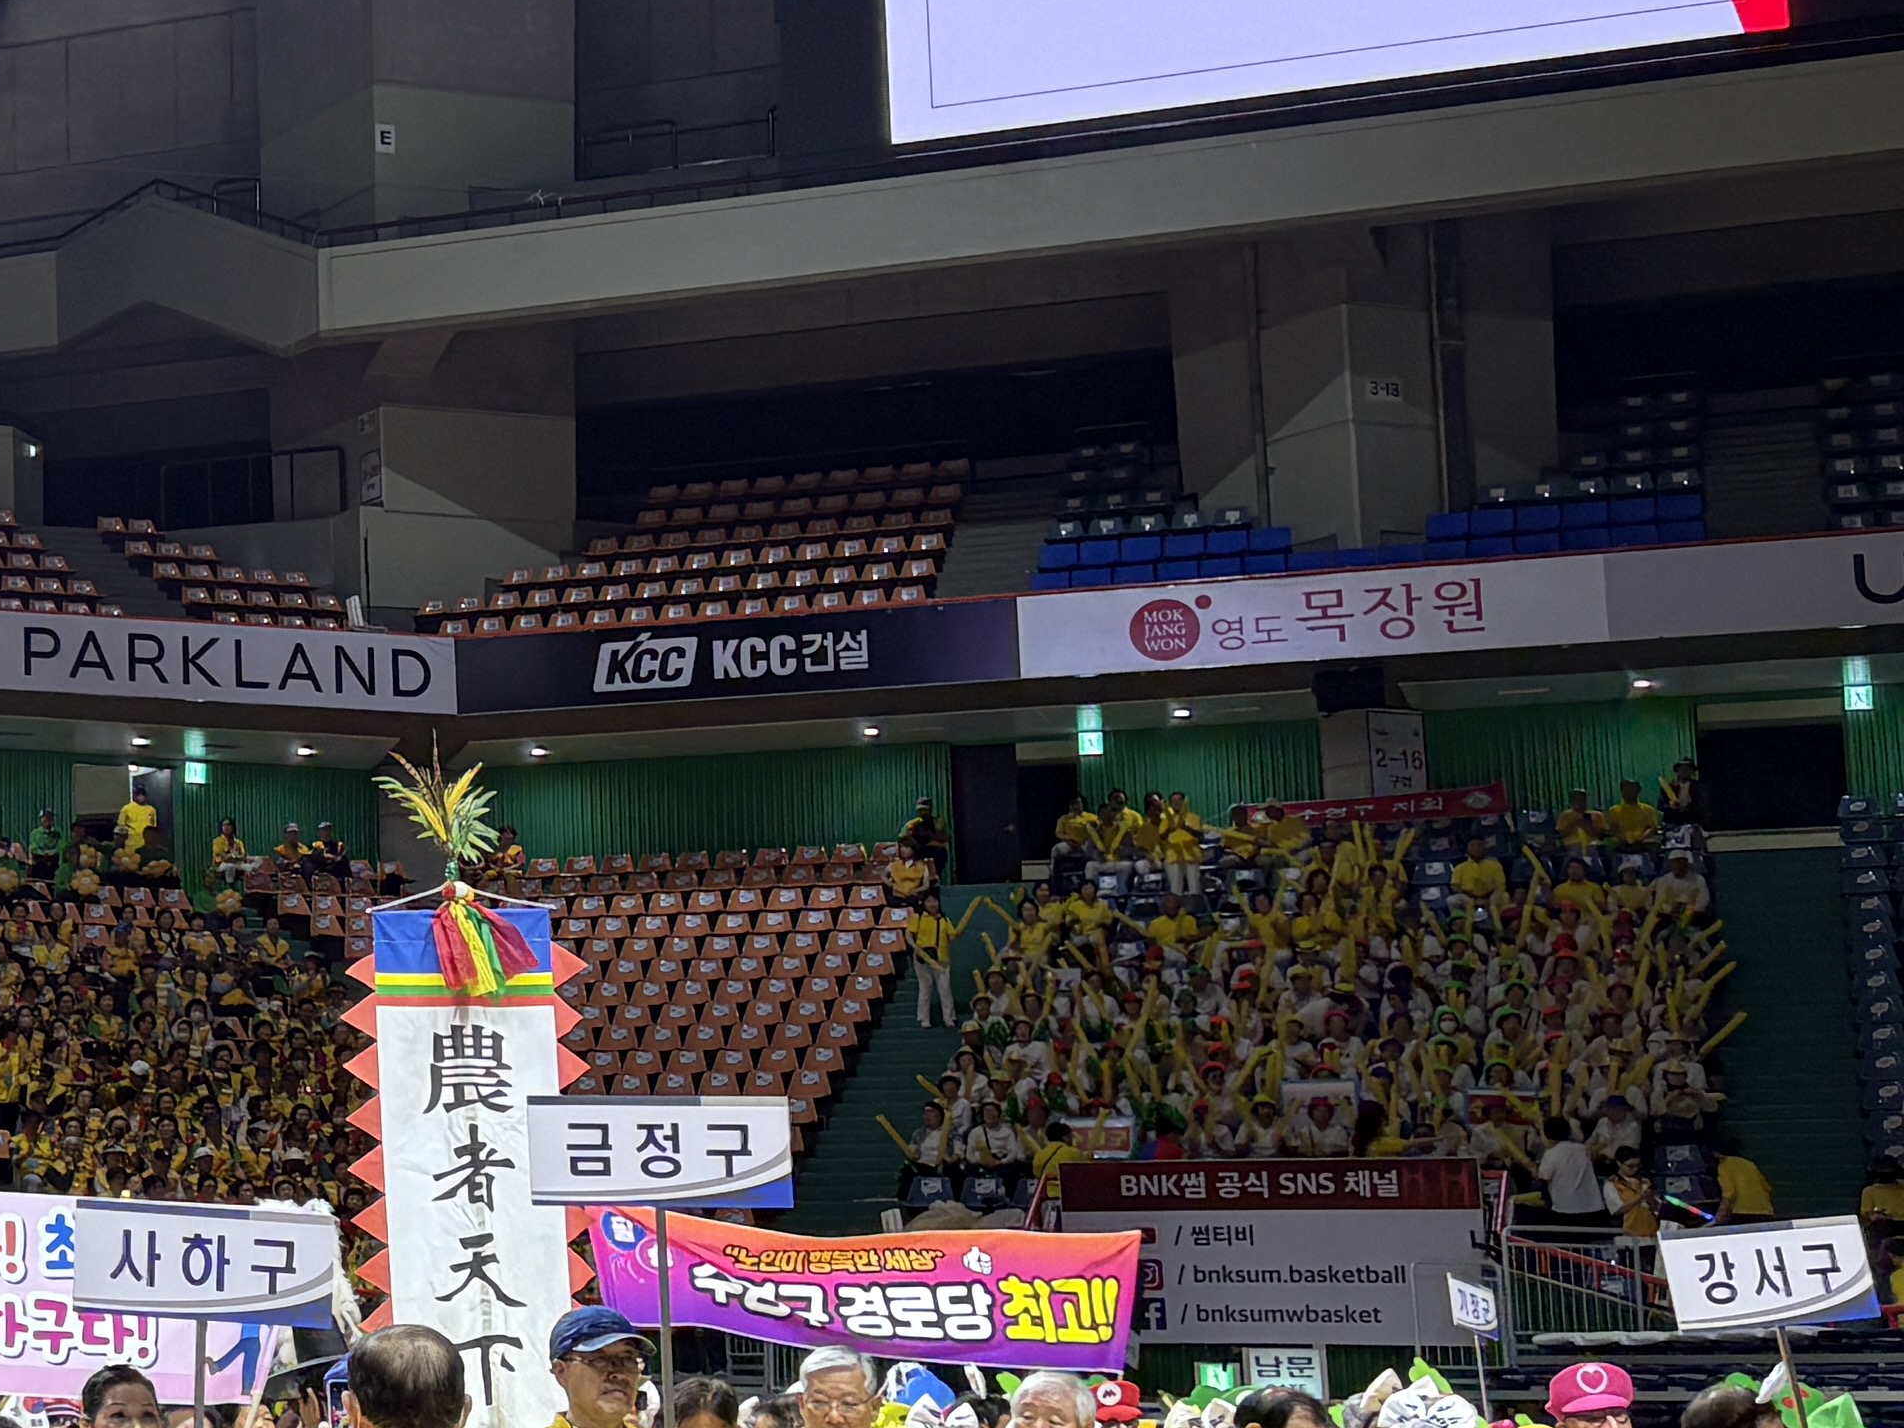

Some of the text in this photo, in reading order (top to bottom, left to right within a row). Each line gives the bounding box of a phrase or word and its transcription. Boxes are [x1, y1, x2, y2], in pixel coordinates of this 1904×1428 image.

[1143, 609, 1185, 625] MOK
[1211, 577, 1487, 651] 영도 목장원
[1144, 622, 1187, 639] JANG
[1144, 635, 1187, 652] WON
[22, 626, 431, 699] PARKLAND
[603, 633, 690, 685] KCC
[712, 629, 869, 680] KCC건설
[1375, 747, 1424, 770] 2-16
[567, 1123, 754, 1178] 금정구
[1121, 1170, 1400, 1199] BNK썸 공식 SNS 채널
[1190, 1222, 1255, 1247] 썸티비
[110, 1229, 298, 1296] 사하구
[1193, 1263, 1407, 1286] bnksum.basketball
[1694, 1243, 1842, 1304] 강서구
[838, 1280, 993, 1341] 경로당
[996, 1274, 1120, 1345] 최고!!
[1196, 1302, 1382, 1326] bnksumwbasket
[1254, 1354, 1314, 1379] 남문
